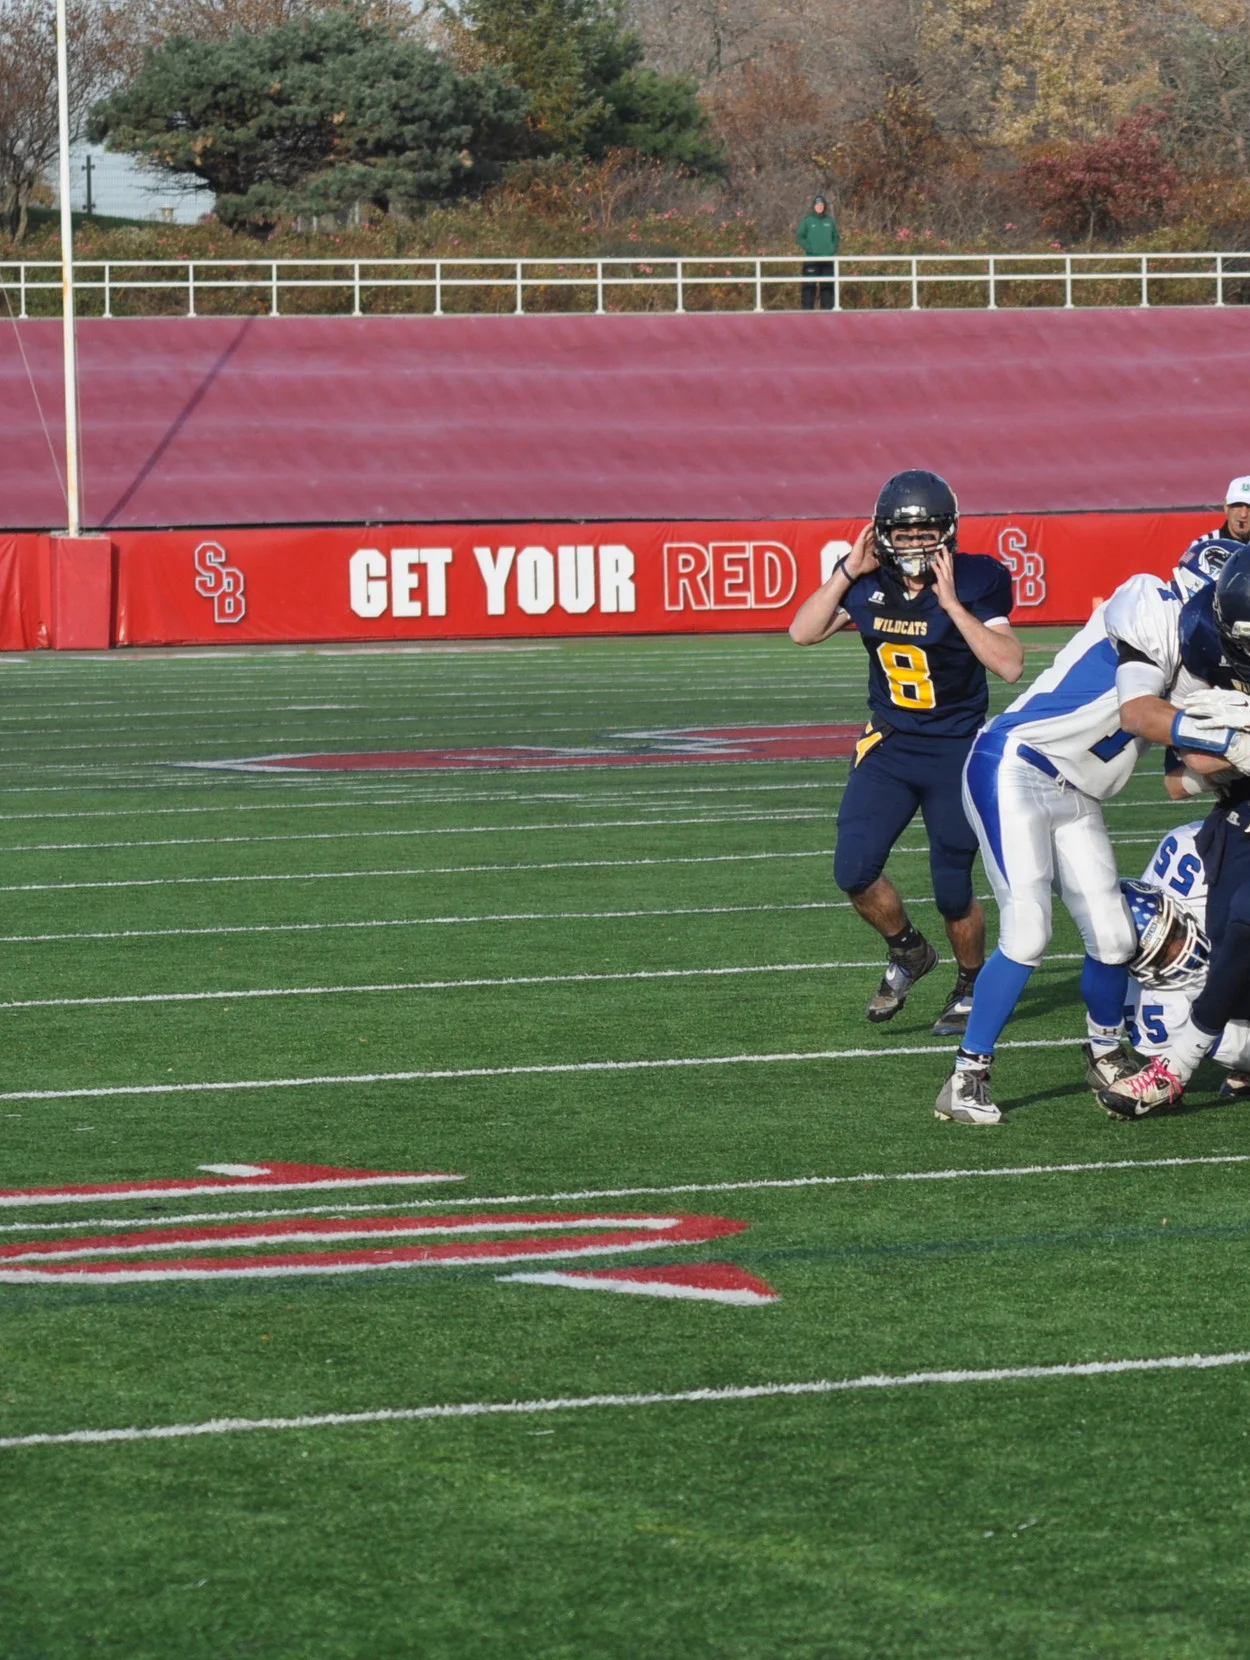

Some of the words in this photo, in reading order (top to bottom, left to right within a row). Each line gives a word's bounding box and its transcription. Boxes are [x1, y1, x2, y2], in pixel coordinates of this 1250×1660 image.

[349, 547, 453, 618] GET
[473, 545, 636, 615] YOUR
[662, 541, 797, 611] RED
[873, 617, 928, 636] WILDCATS
[876, 641, 936, 709] 8
